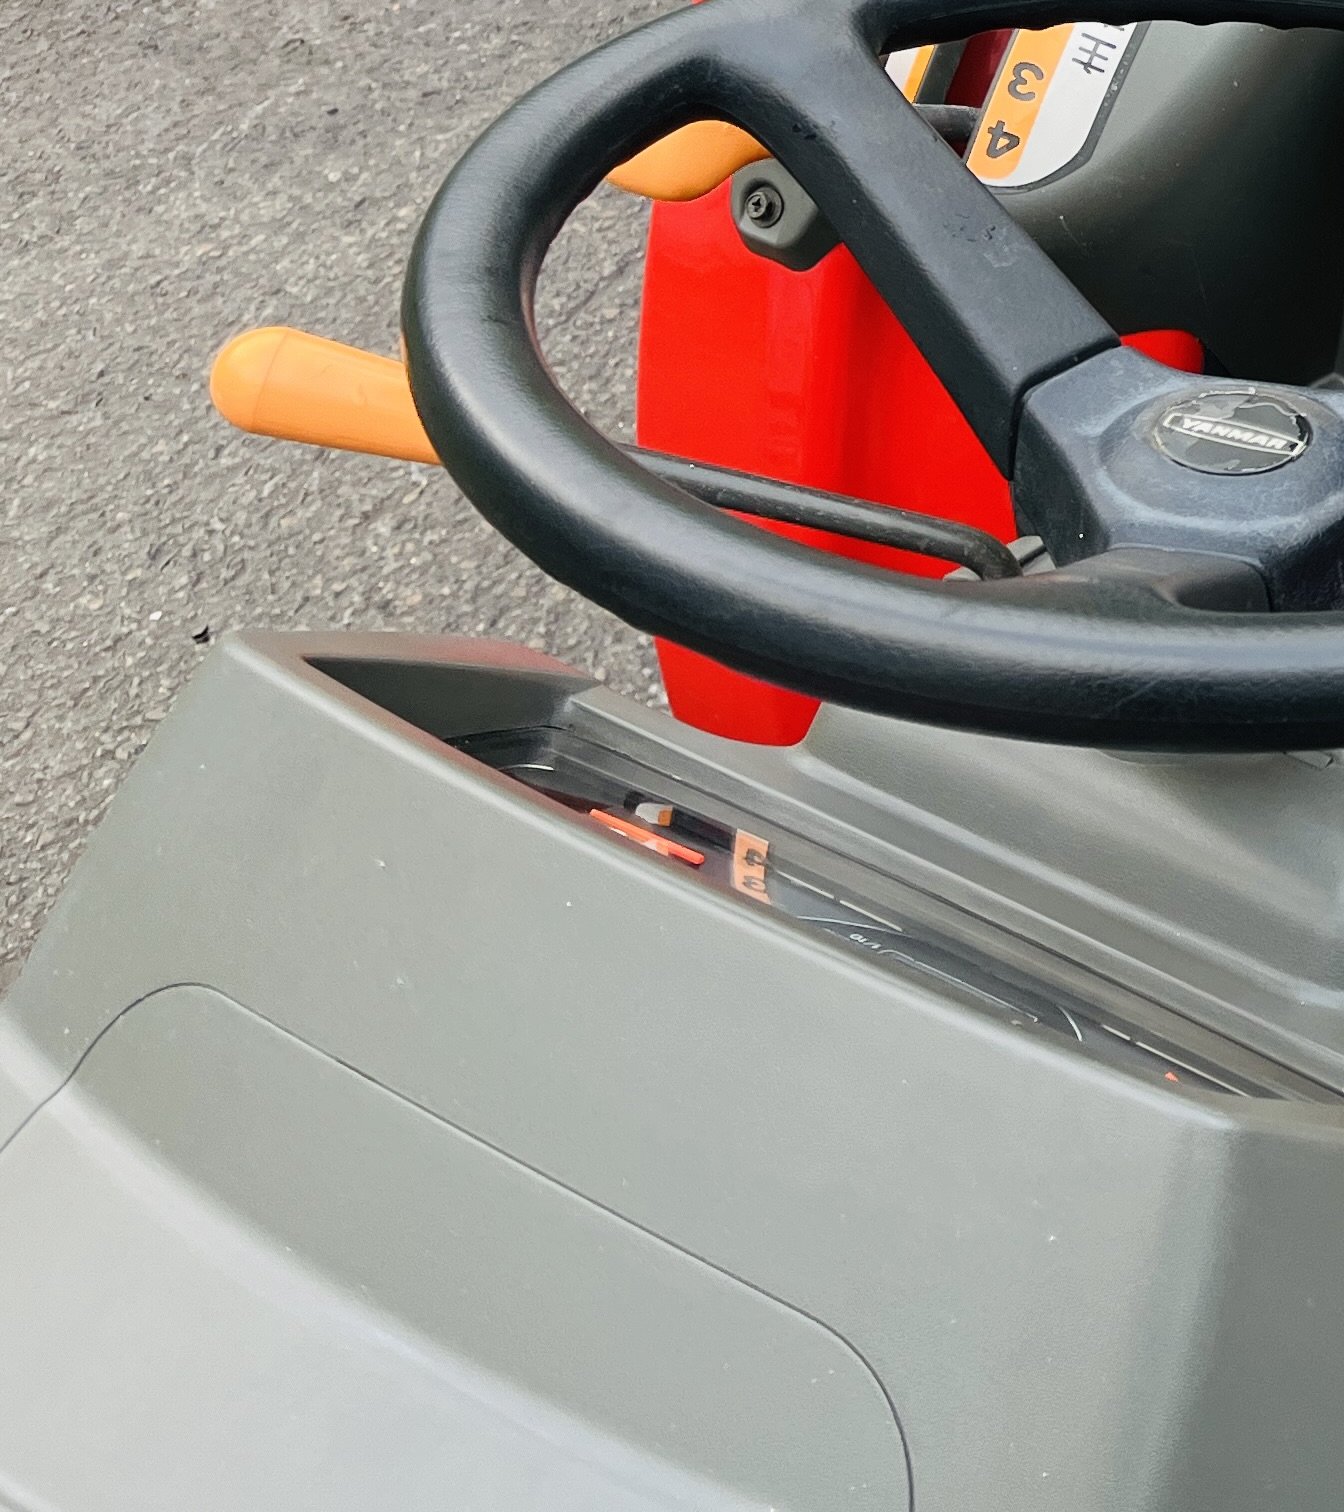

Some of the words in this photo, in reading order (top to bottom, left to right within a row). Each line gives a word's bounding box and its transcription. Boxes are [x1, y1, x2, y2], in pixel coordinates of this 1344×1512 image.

[1007, 61, 1044, 101] 3
[986, 119, 1020, 159] 4
[1181, 417, 1288, 450] YANMAR
